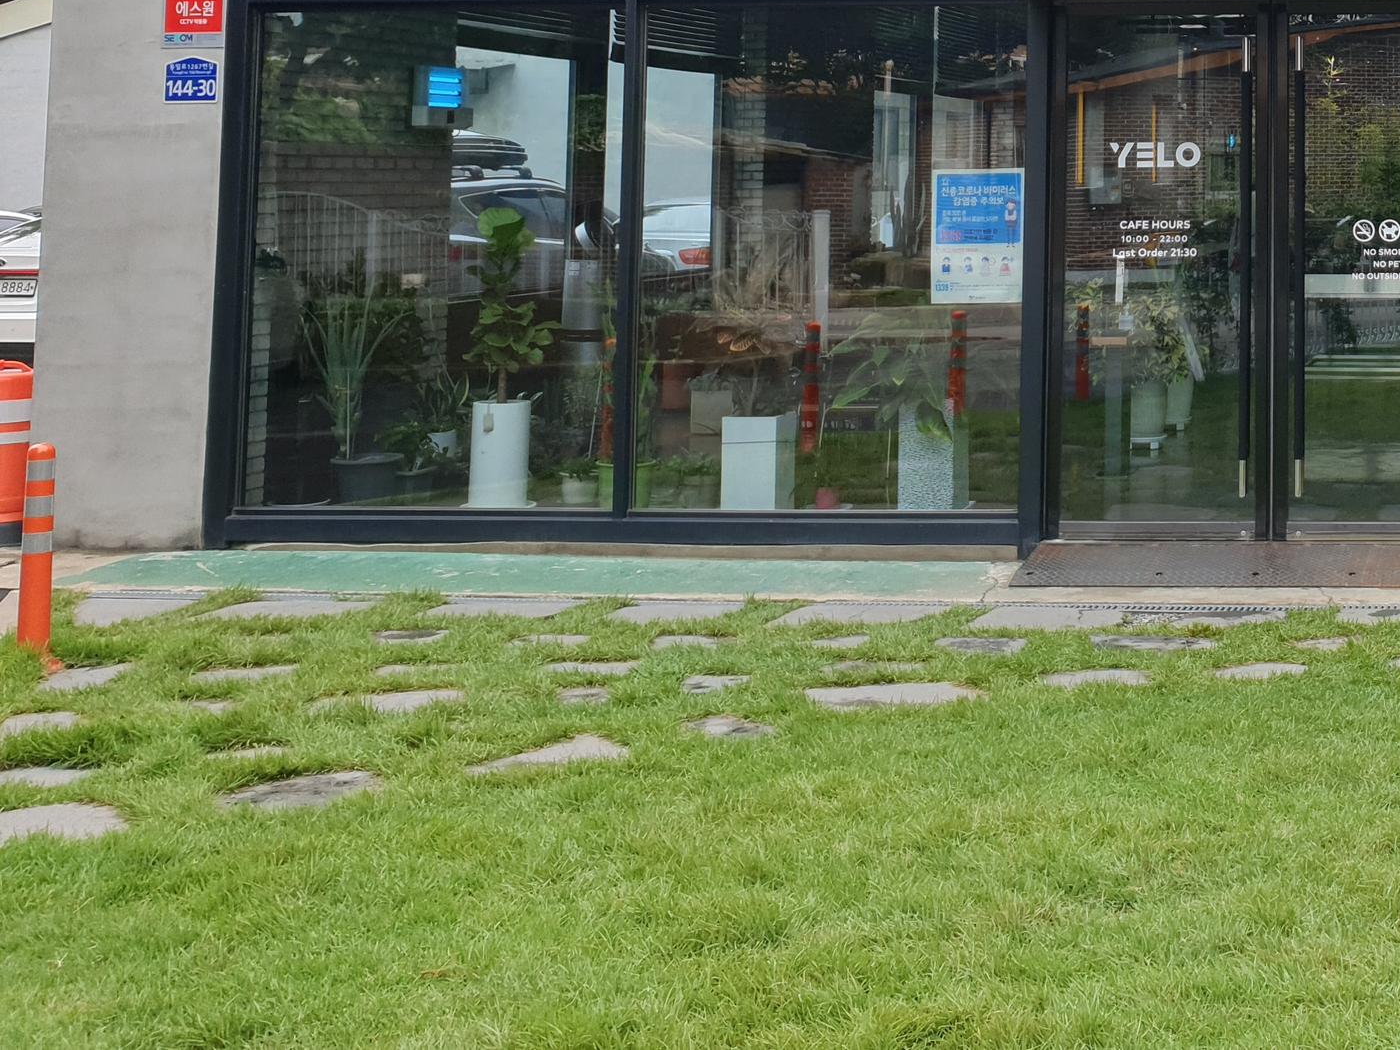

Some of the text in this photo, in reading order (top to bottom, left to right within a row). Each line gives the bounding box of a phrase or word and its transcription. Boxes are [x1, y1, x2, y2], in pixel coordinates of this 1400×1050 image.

[175, 0, 214, 17] 에스원
[166, 79, 216, 97] 144-30
[1109, 141, 1201, 168] YELO
[1119, 220, 1191, 230] CAFE HOURS
[1120, 235, 1149, 243] 10:00
[1159, 235, 1188, 243] 22:00
[1112, 248, 1197, 257] Last Order 21:30
[1363, 248, 1377, 256] NO
[1373, 260, 1387, 268] NO
[1351, 272, 1365, 280] NO
[1, 281, 31, 293] 8884
